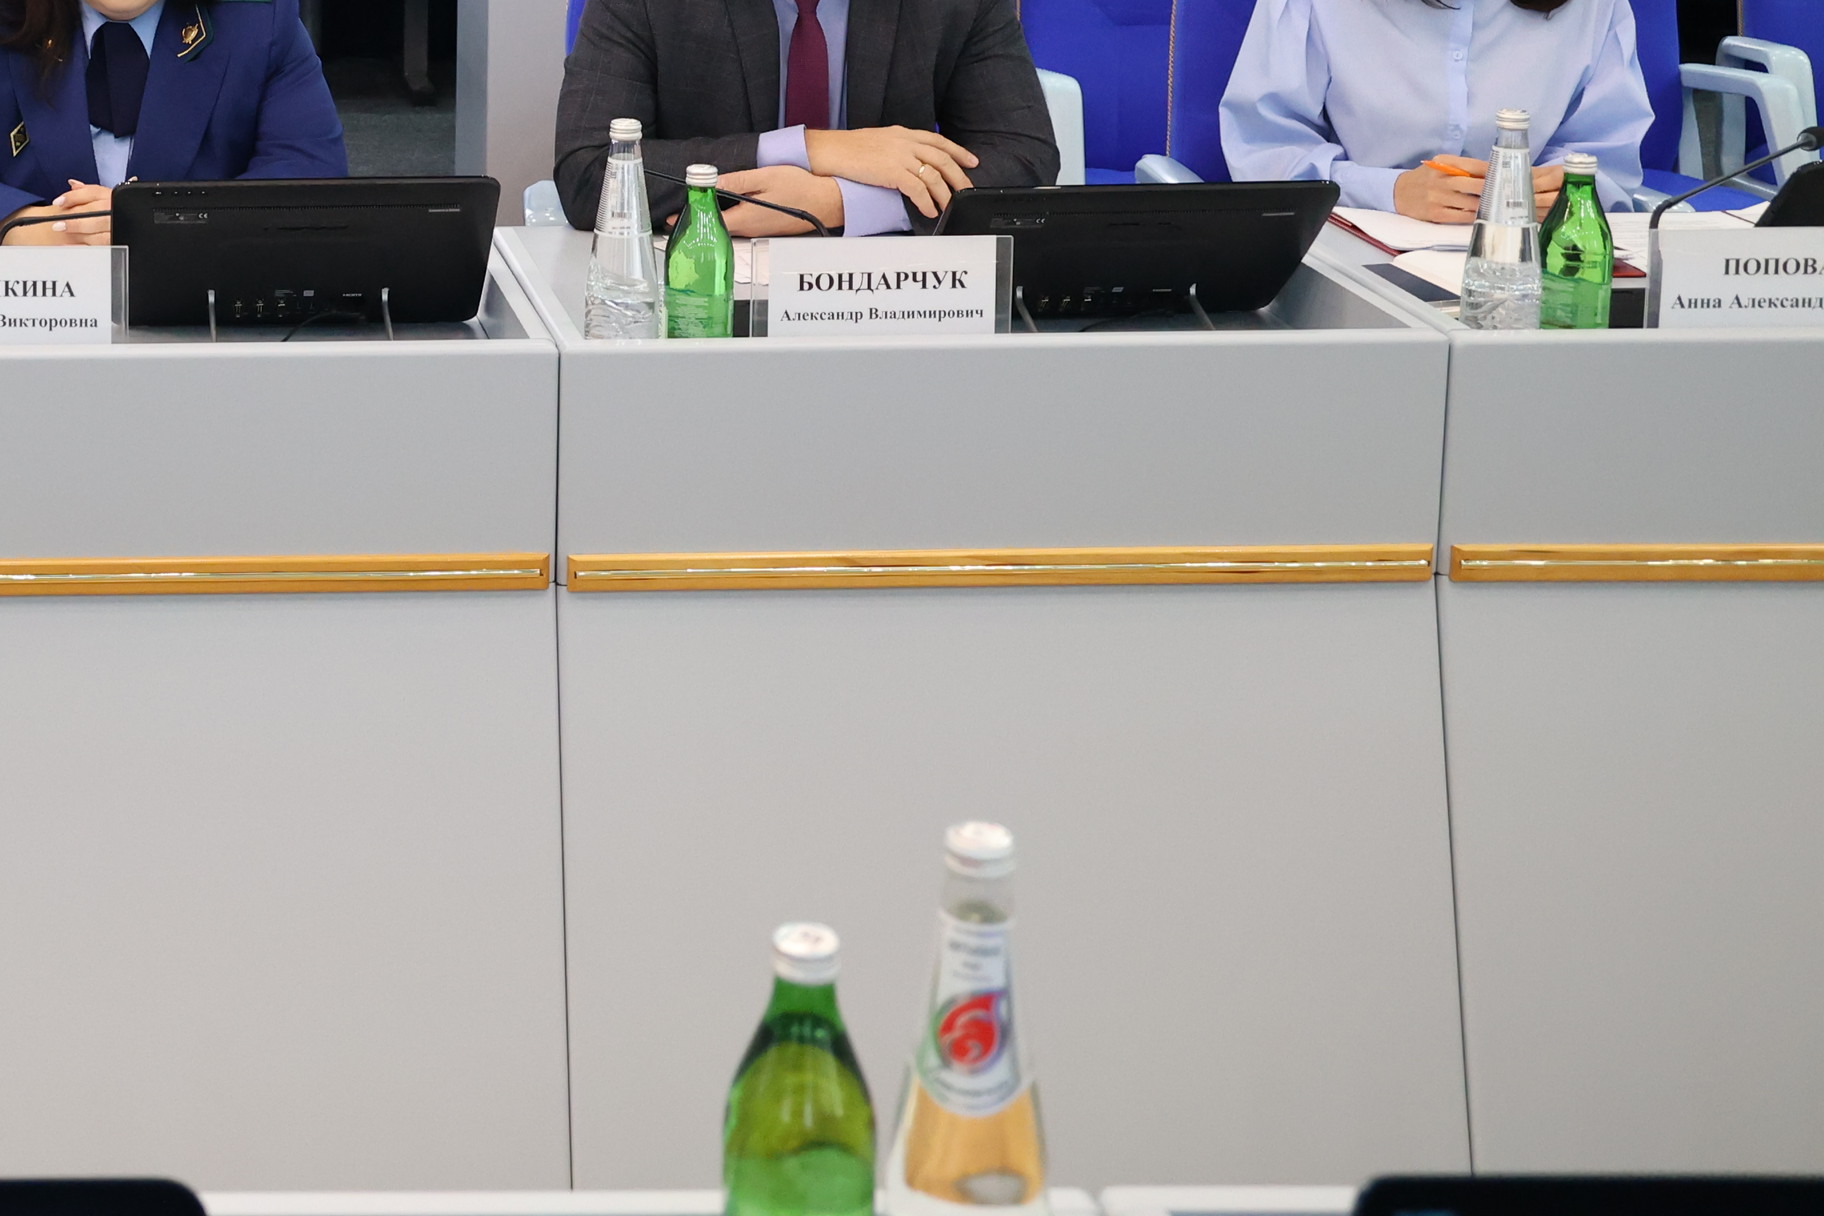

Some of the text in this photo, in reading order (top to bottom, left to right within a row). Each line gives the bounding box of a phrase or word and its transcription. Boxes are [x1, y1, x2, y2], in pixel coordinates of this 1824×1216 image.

[797, 269, 969, 295] БОНДАРЧУК
[1671, 294, 1722, 310] Анна
[780, 307, 984, 324] Александр Владимирович
